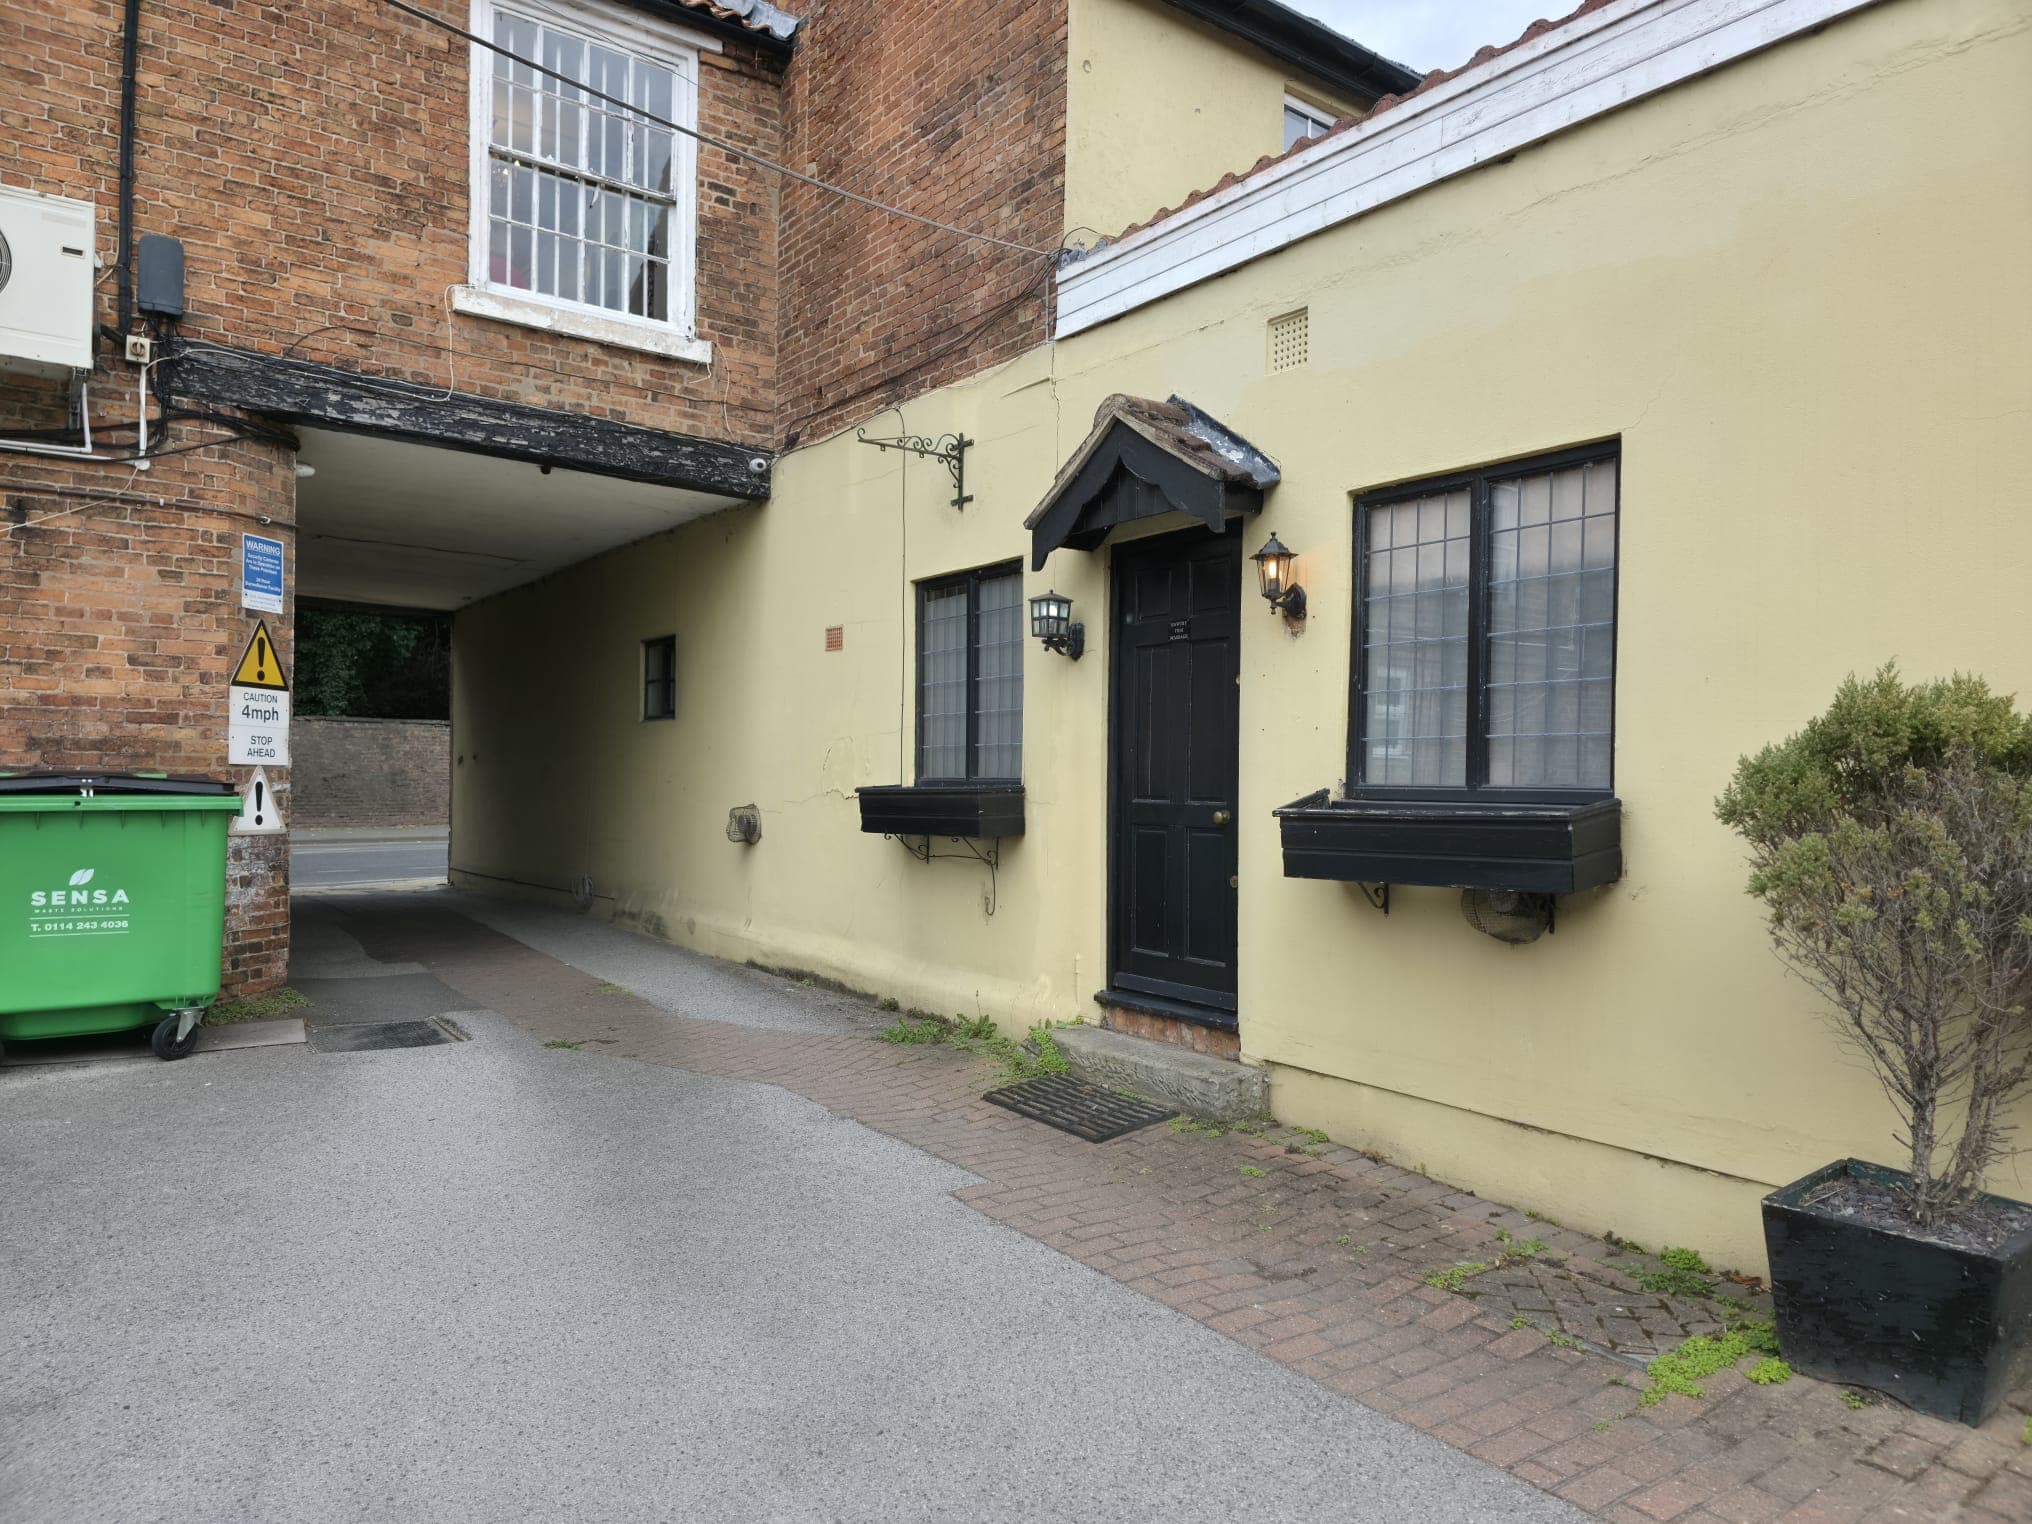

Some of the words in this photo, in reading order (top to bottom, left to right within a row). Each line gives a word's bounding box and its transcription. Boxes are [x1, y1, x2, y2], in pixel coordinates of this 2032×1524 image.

[246, 540, 281, 556] WARNING
[243, 692, 278, 704] CAUTION
[241, 705, 279, 723] 4mph
[250, 735, 273, 746] STOP
[247, 748, 276, 758] AHEAD
[31, 889, 130, 906] SENSA
[44, 922, 74, 931] 0114
[76, 921, 98, 930] 243
